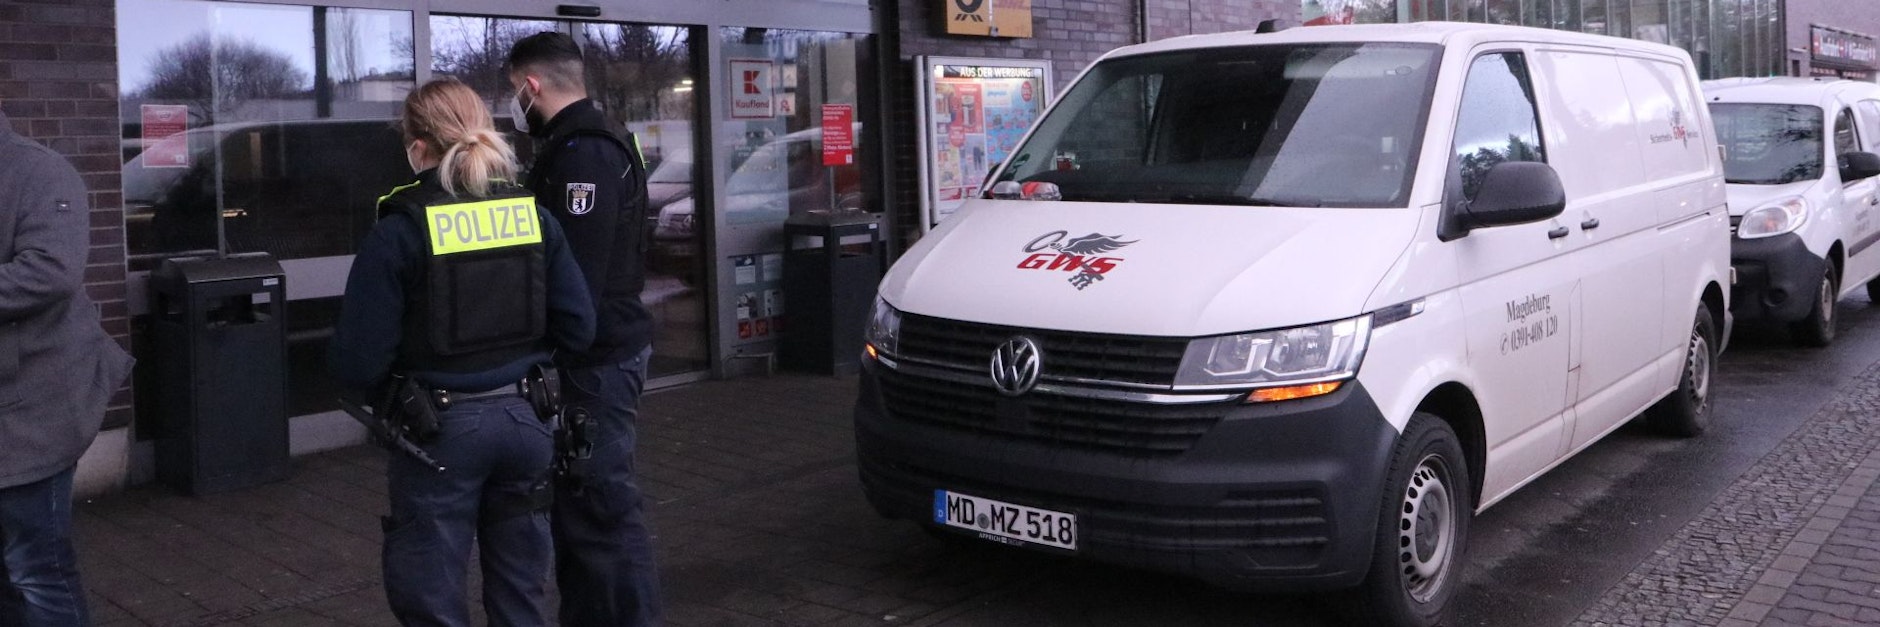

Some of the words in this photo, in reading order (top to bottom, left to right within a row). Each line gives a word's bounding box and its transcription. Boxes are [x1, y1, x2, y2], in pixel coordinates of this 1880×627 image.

[960, 67, 977, 78] AUS
[977, 67, 993, 78] DER
[994, 67, 1031, 78] WERBUNG
[735, 99, 770, 109] Kaufland
[434, 204, 535, 247] POLIZEI
[1017, 252, 1124, 275] GWS
[1506, 293, 1550, 323] Magdeburg
[1510, 320, 1543, 352] 0391-408
[1546, 314, 1558, 338] 120
[947, 494, 975, 526] MD
[990, 503, 1021, 536] MZ
[1026, 510, 1073, 546] 518
